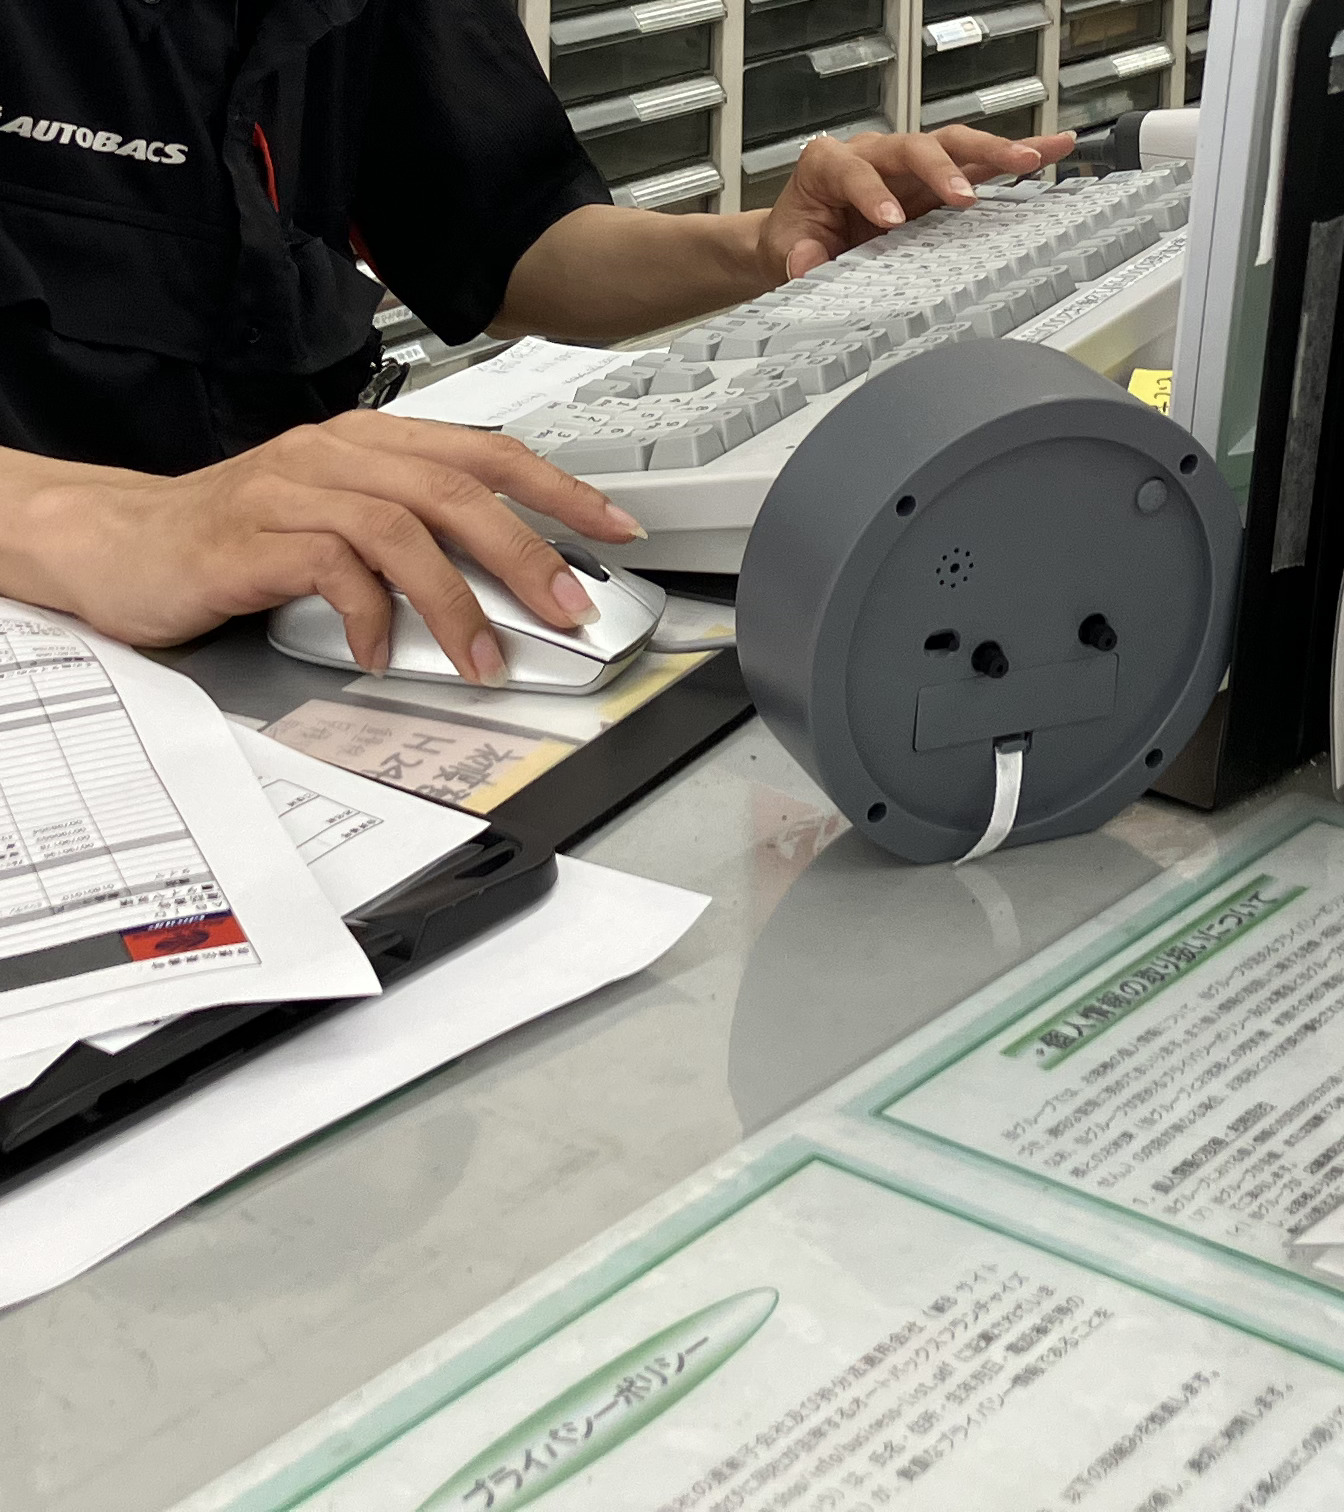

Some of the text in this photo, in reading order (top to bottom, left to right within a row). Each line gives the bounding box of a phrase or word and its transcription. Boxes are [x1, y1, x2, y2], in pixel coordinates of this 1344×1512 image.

[461, 1335, 711, 1512] プライバシーポリシー
